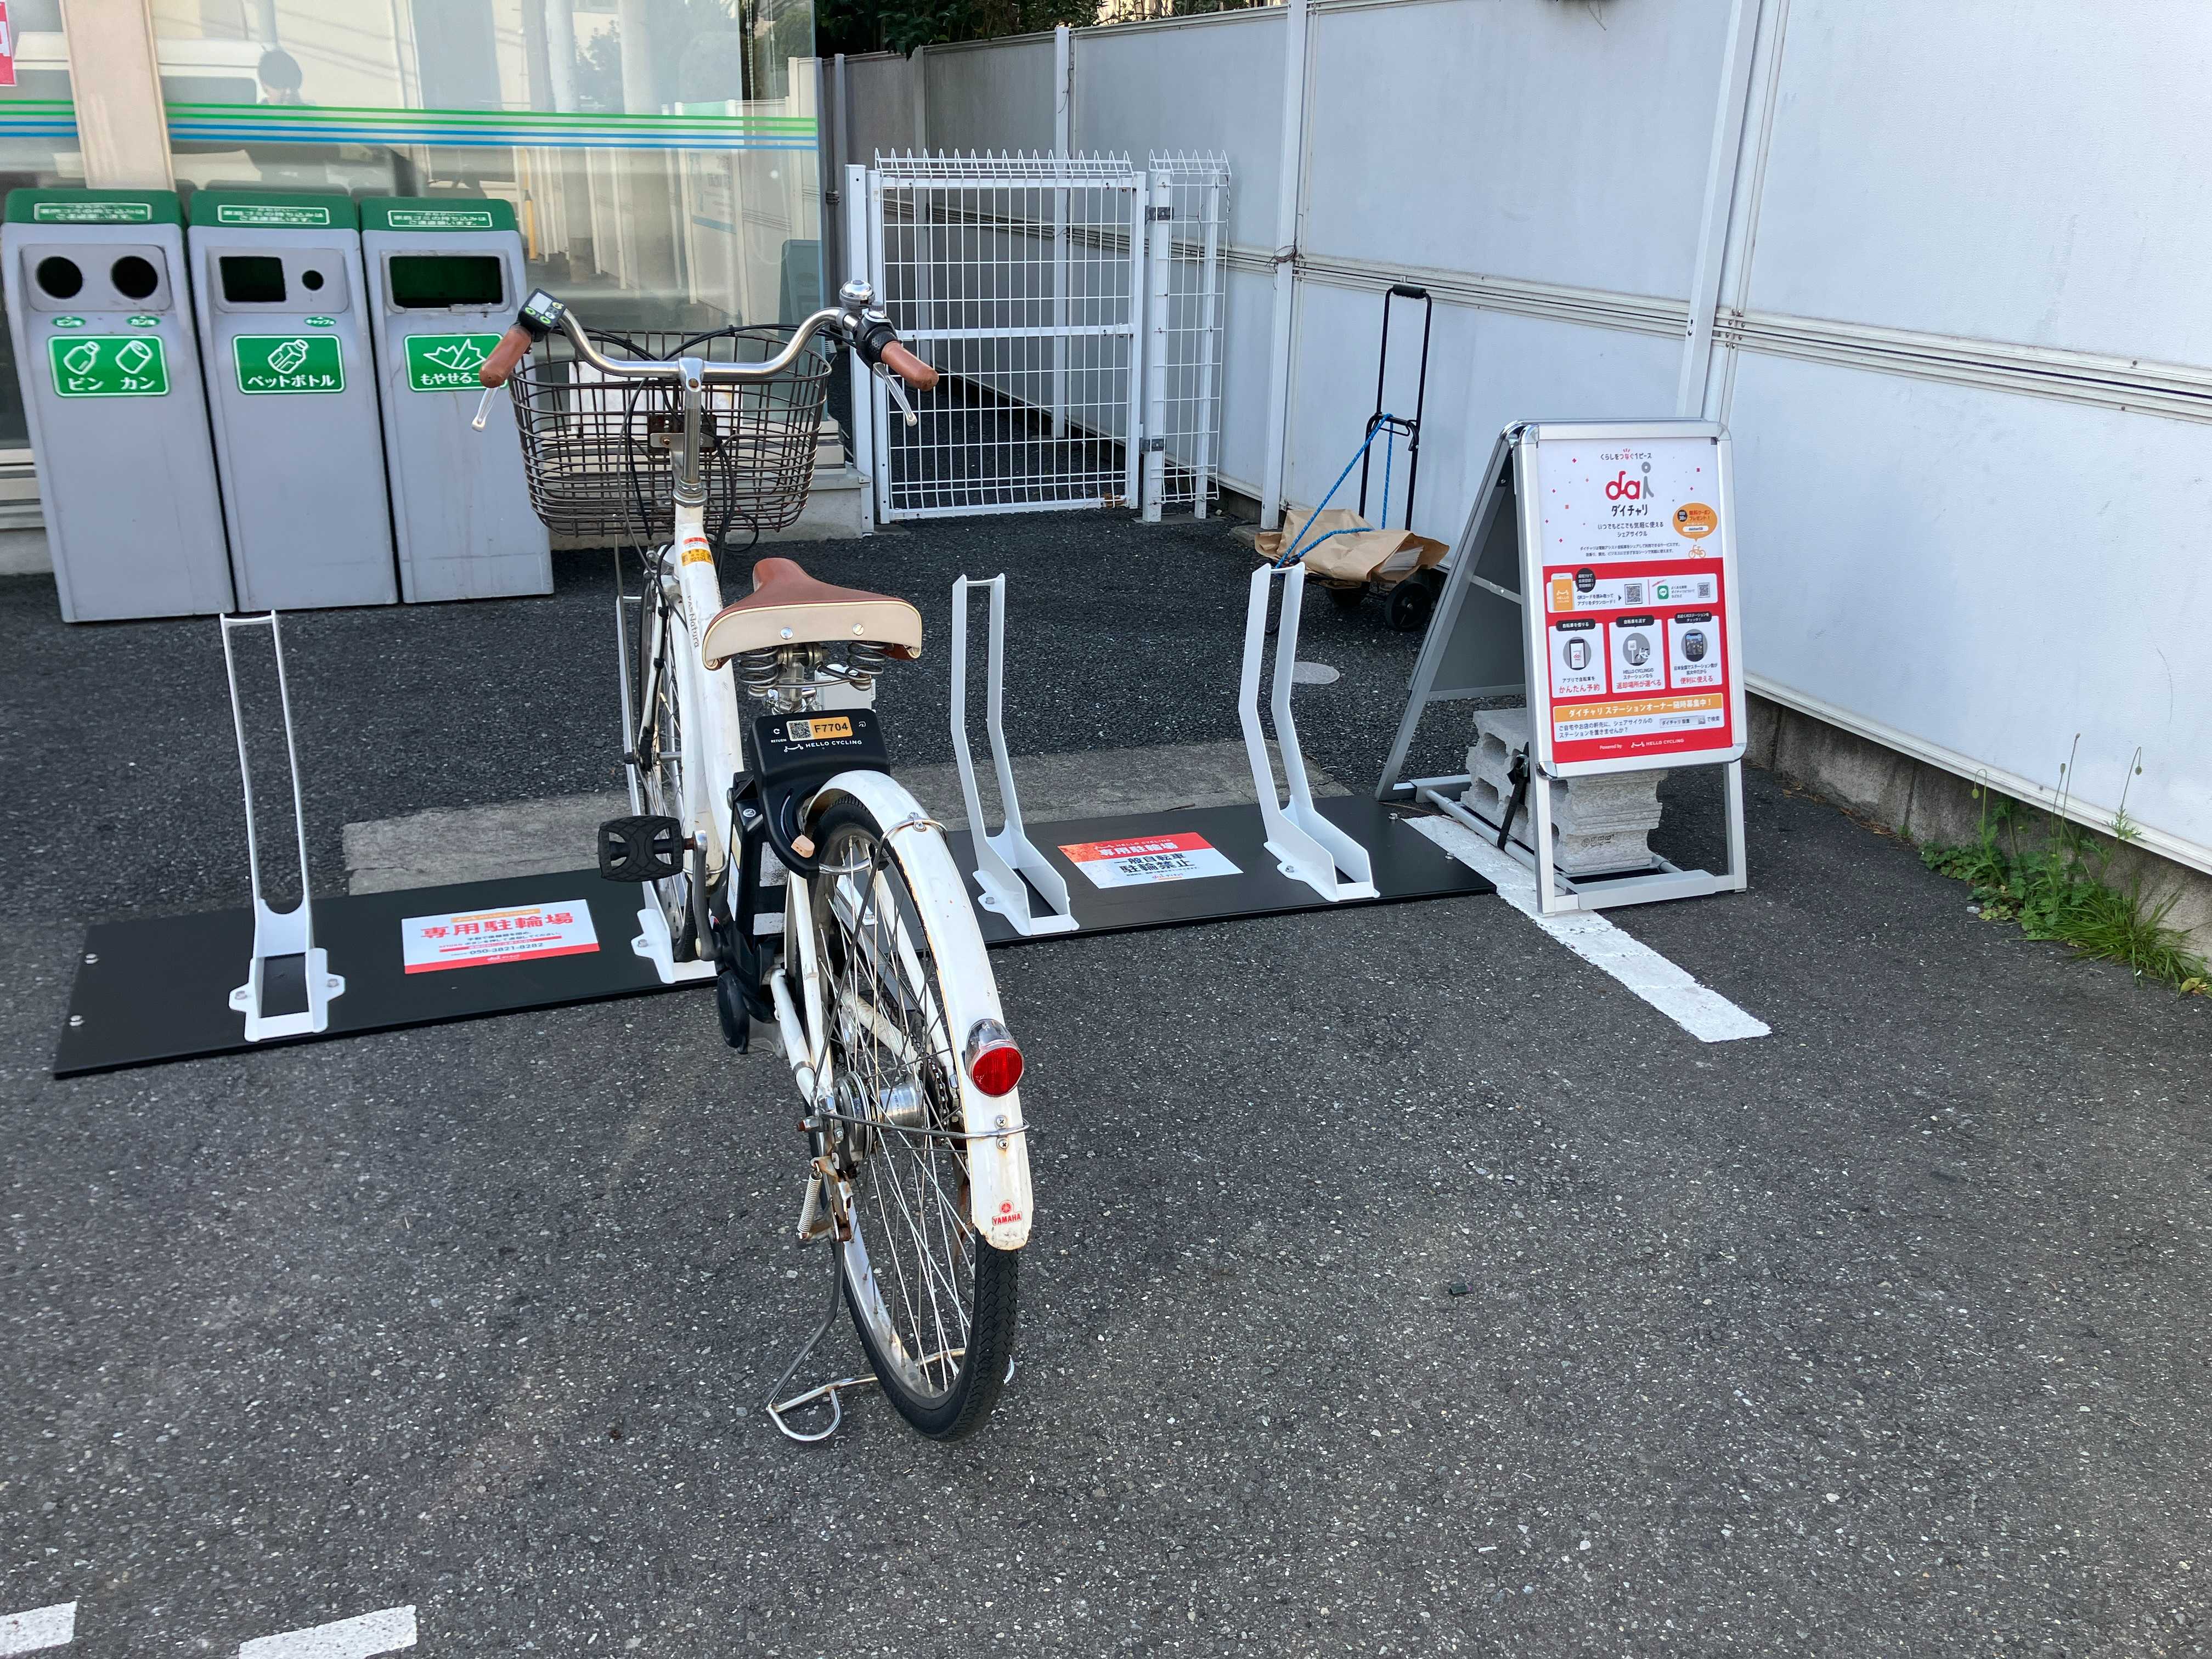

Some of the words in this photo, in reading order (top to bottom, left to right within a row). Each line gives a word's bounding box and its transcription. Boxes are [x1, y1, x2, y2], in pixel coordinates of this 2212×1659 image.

[68, 377, 104, 391] ビン
[120, 377, 155, 390] カン
[247, 374, 335, 388] ペットボトル
[1600, 452, 1652, 460] くらしをつなぐ1ピース
[1605, 461, 1654, 500] dai
[1611, 504, 1648, 516] ダイチャリ
[1598, 522, 1664, 530] いつでもどこでも気軽に使える
[689, 613, 699, 648] Natura
[1680, 675, 1713, 684] 便利に使える
[1559, 684, 1600, 693] かんたん予約
[1569, 707, 1602, 718] ダイチャリ
[814, 723, 848, 733] F7704
[1097, 842, 1179, 856] 専用駐輪場
[1114, 853, 1187, 865] 一般自転車
[1119, 859, 1195, 873] 駐輪禁止
[421, 912, 574, 938] 専用駐輪場
[470, 943, 544, 955] 050-3821-8282
[992, 1213, 1021, 1225] YAMAHA
